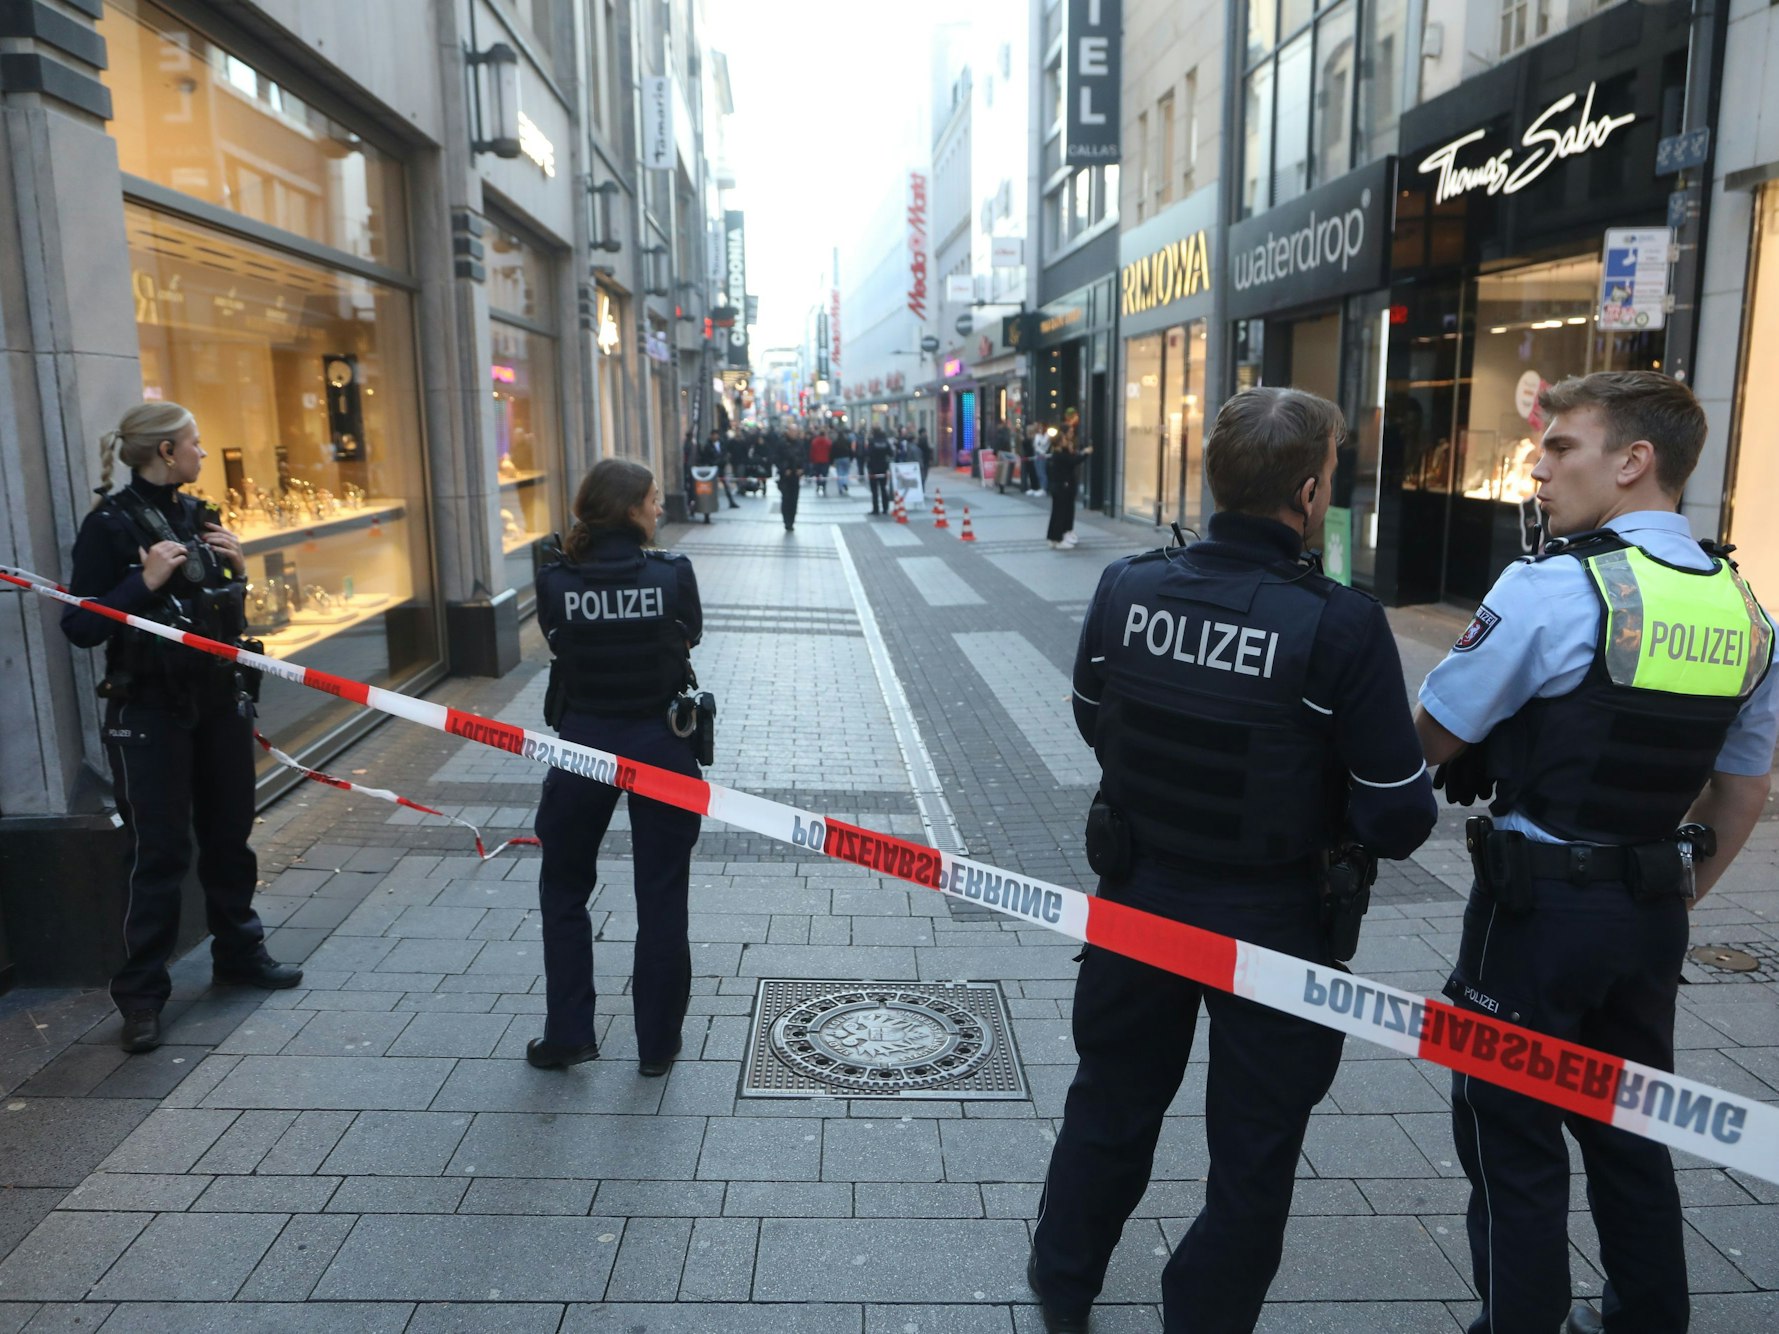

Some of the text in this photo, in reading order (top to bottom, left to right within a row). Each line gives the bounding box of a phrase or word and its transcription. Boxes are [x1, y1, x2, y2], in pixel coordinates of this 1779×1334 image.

[1068, 143, 1117, 157] CALLAS
[1418, 81, 1636, 205] Thomas Sabo
[1122, 229, 1210, 317] RIMOWA
[1234, 206, 1365, 290] waterdrop
[564, 587, 664, 620] POLIZEI
[1123, 603, 1279, 679] POLIZEI
[1649, 621, 1744, 667] POLIZEI
[1464, 986, 1499, 1013] POLIZEI
